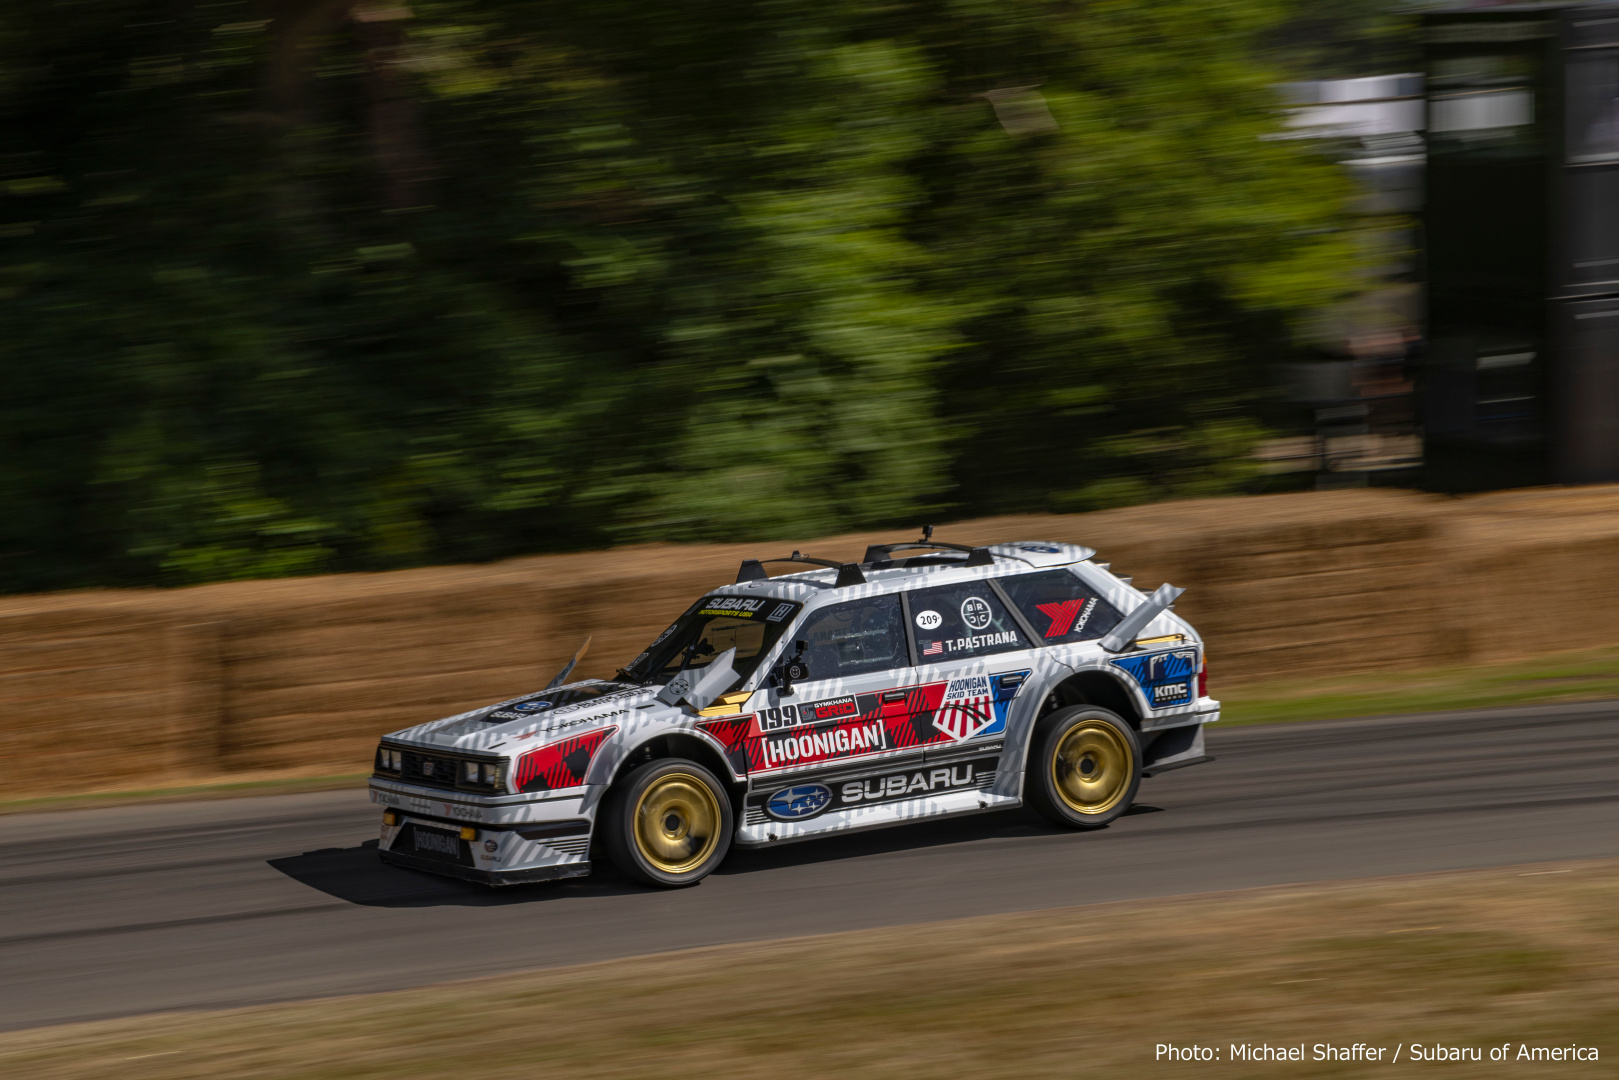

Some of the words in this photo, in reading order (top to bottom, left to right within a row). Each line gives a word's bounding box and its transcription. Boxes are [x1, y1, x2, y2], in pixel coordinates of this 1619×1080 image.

[705, 597, 766, 611] SUBARU
[698, 609, 738, 617] MOTORSPORTS
[920, 614, 938, 625] 209
[1073, 597, 1099, 633] YOKOHAMA
[949, 676, 988, 692] HOONIGAN
[1154, 682, 1188, 698] KMC
[946, 691, 965, 700] SKID
[967, 688, 989, 697] TEAM
[813, 697, 854, 708] GYMKHANA
[538, 709, 630, 733] YOKOHAMA
[758, 704, 798, 731] 199
[841, 764, 975, 803] SUBARU
